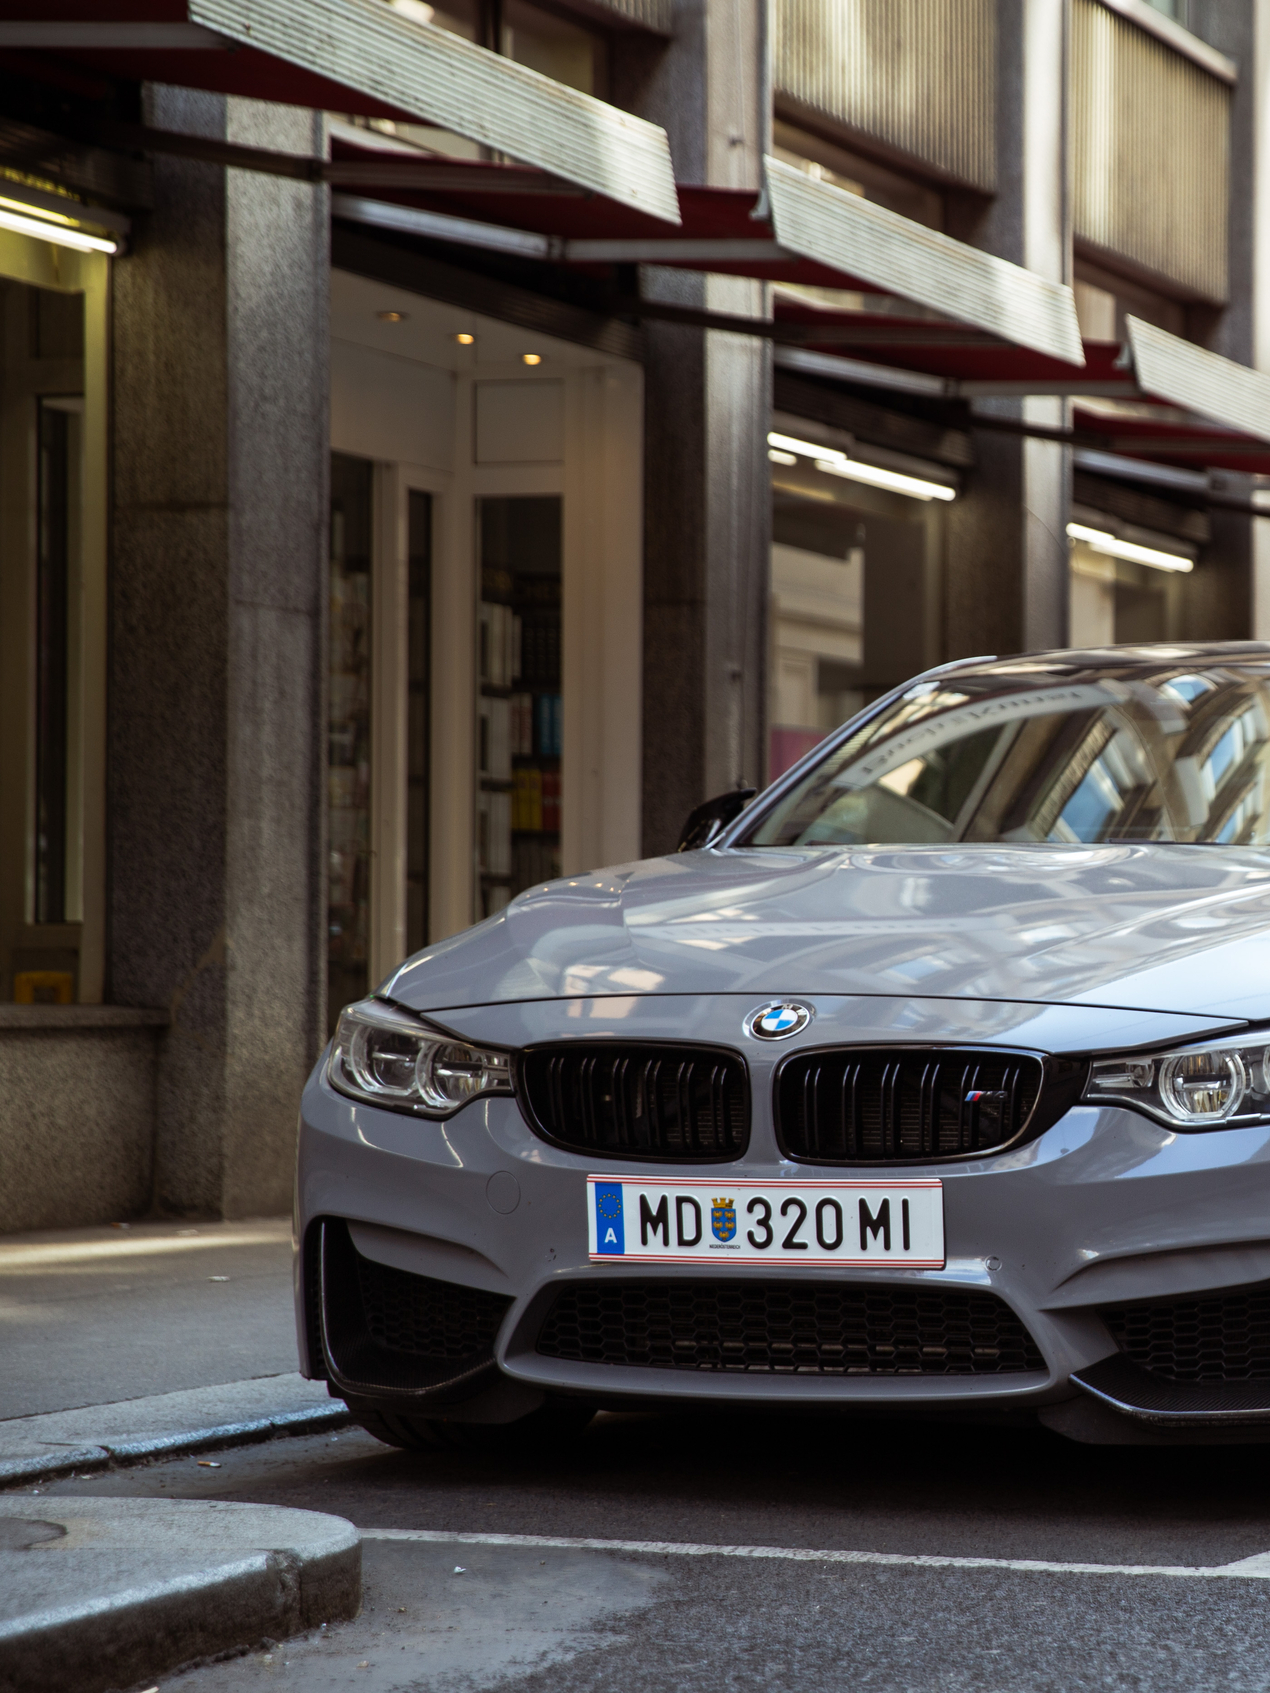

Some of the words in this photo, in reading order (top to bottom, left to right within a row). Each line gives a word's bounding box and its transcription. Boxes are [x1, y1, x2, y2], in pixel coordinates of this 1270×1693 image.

[604, 1227, 618, 1244] A
[639, 1193, 703, 1247] MD
[746, 1196, 844, 1250] 320
[858, 1197, 911, 1251] MI
